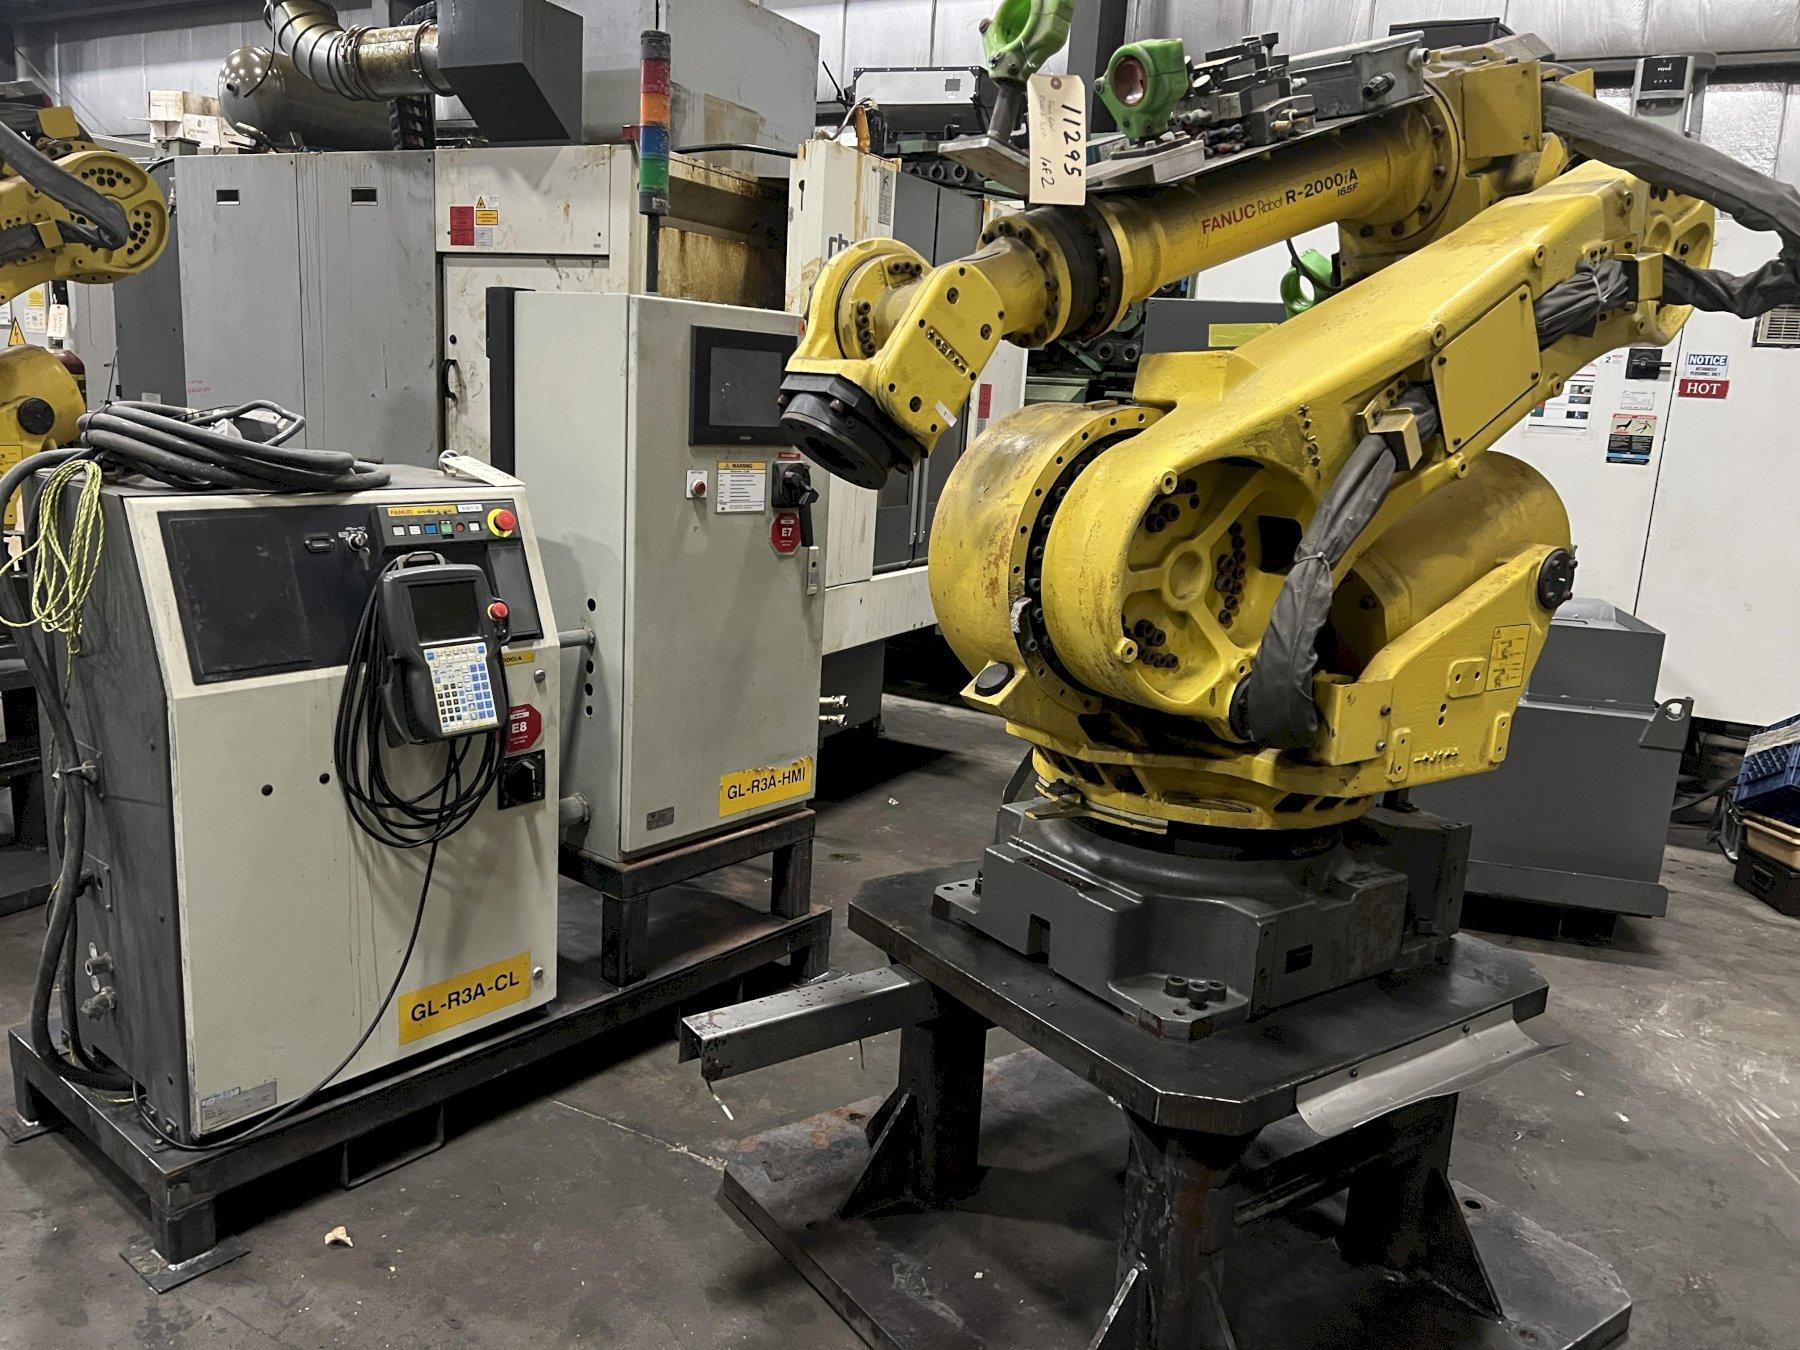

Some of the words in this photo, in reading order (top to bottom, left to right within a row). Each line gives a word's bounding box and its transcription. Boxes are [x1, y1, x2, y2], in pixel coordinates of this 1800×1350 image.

[1061, 104, 1082, 177] 11295
[1337, 183, 1359, 197] 165F
[1201, 203, 1257, 234] FANUC
[1257, 197, 1283, 215] Robot
[1285, 168, 1358, 205] R-2000iA
[1689, 355, 1727, 366] NOTICE
[1686, 382, 1721, 395] HOT
[390, 508, 413, 516] FANUC
[781, 527, 793, 537] E7
[511, 721, 528, 734] E8
[727, 766, 806, 800] GL-R3A-HMI
[411, 971, 520, 1022] GL-R3A-CL
